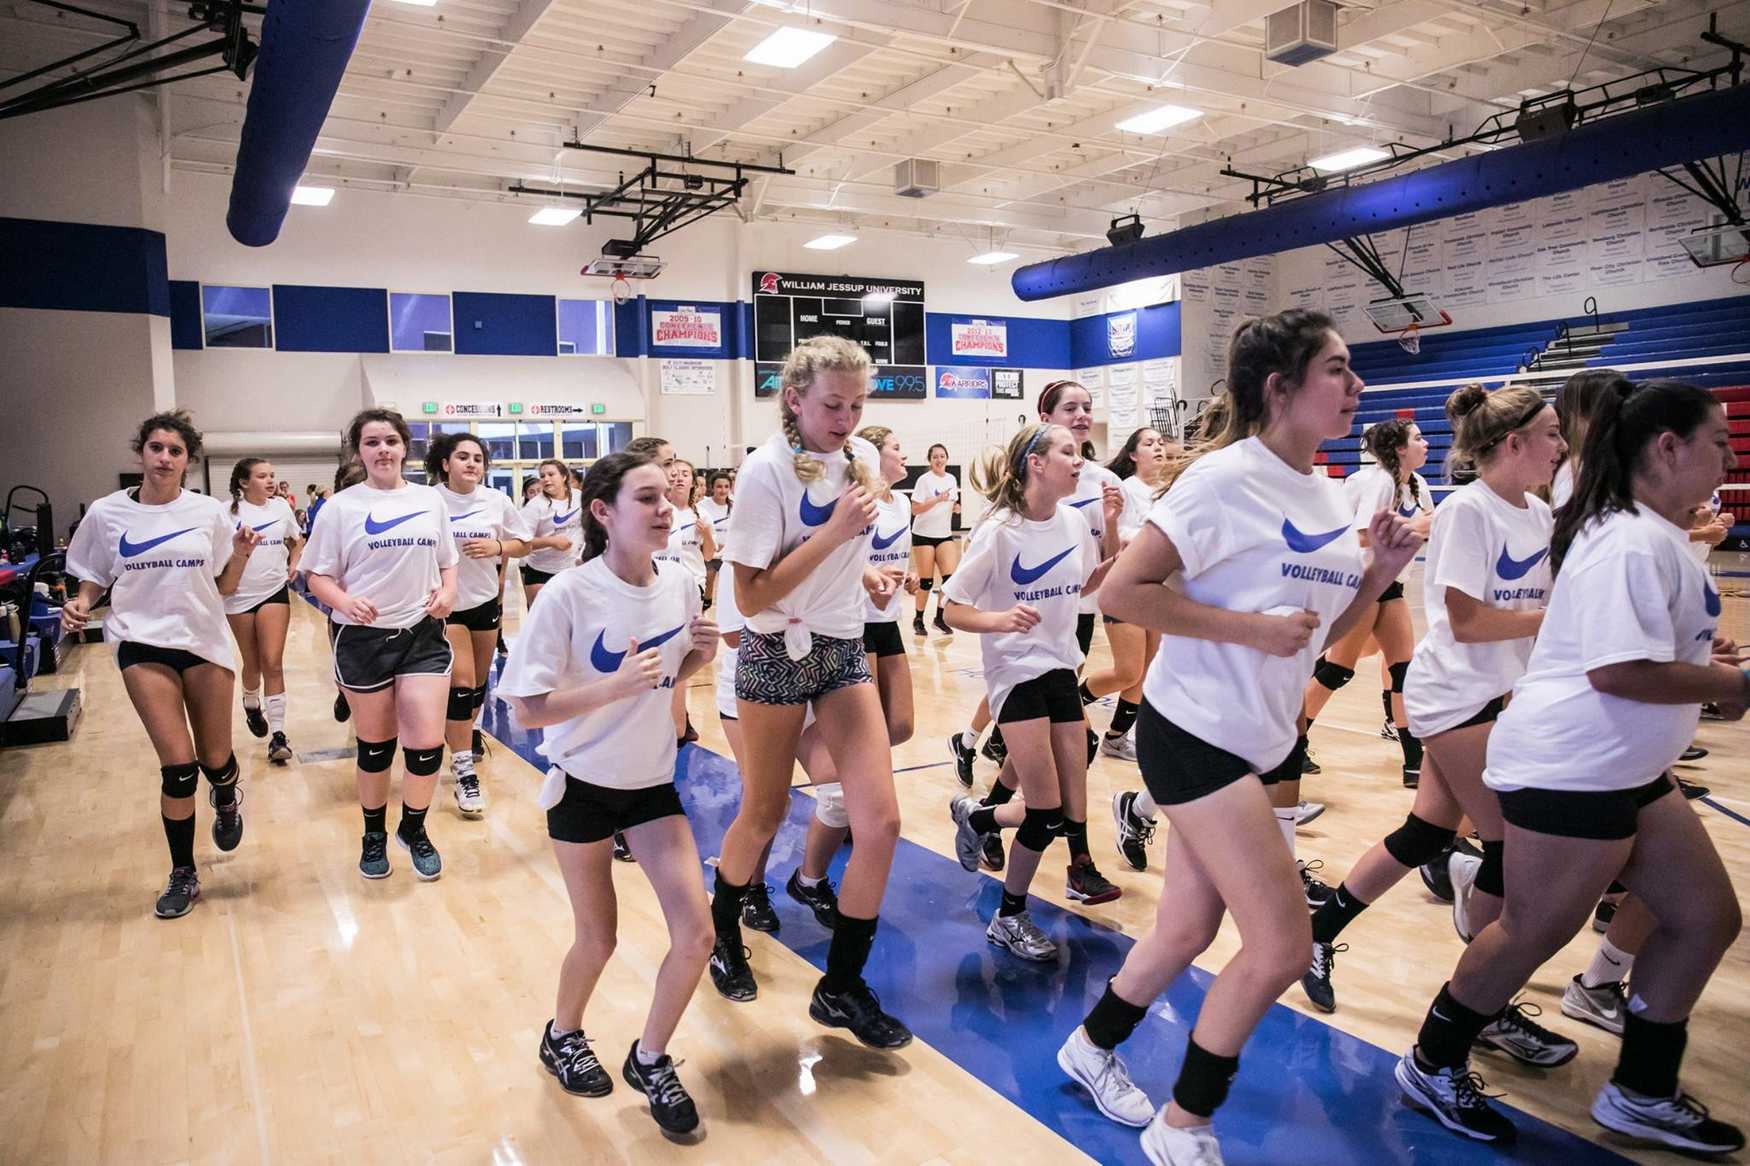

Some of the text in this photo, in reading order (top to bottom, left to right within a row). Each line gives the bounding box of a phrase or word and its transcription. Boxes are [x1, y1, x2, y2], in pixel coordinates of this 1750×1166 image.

[782, 280, 922, 296] WILLIAM JESSUP UNIVERSITY
[800, 315, 886, 326] HOME GUEST
[656, 328, 718, 343] CHAMPIONS
[955, 340, 1004, 353] CHAMPIONS
[540, 404, 573, 414] RESTROOMS
[368, 537, 414, 550] VOLLEYBALL
[1281, 562, 1345, 586] VOLLEYBALL
[1014, 585, 1063, 601] VOLLEYBALL
